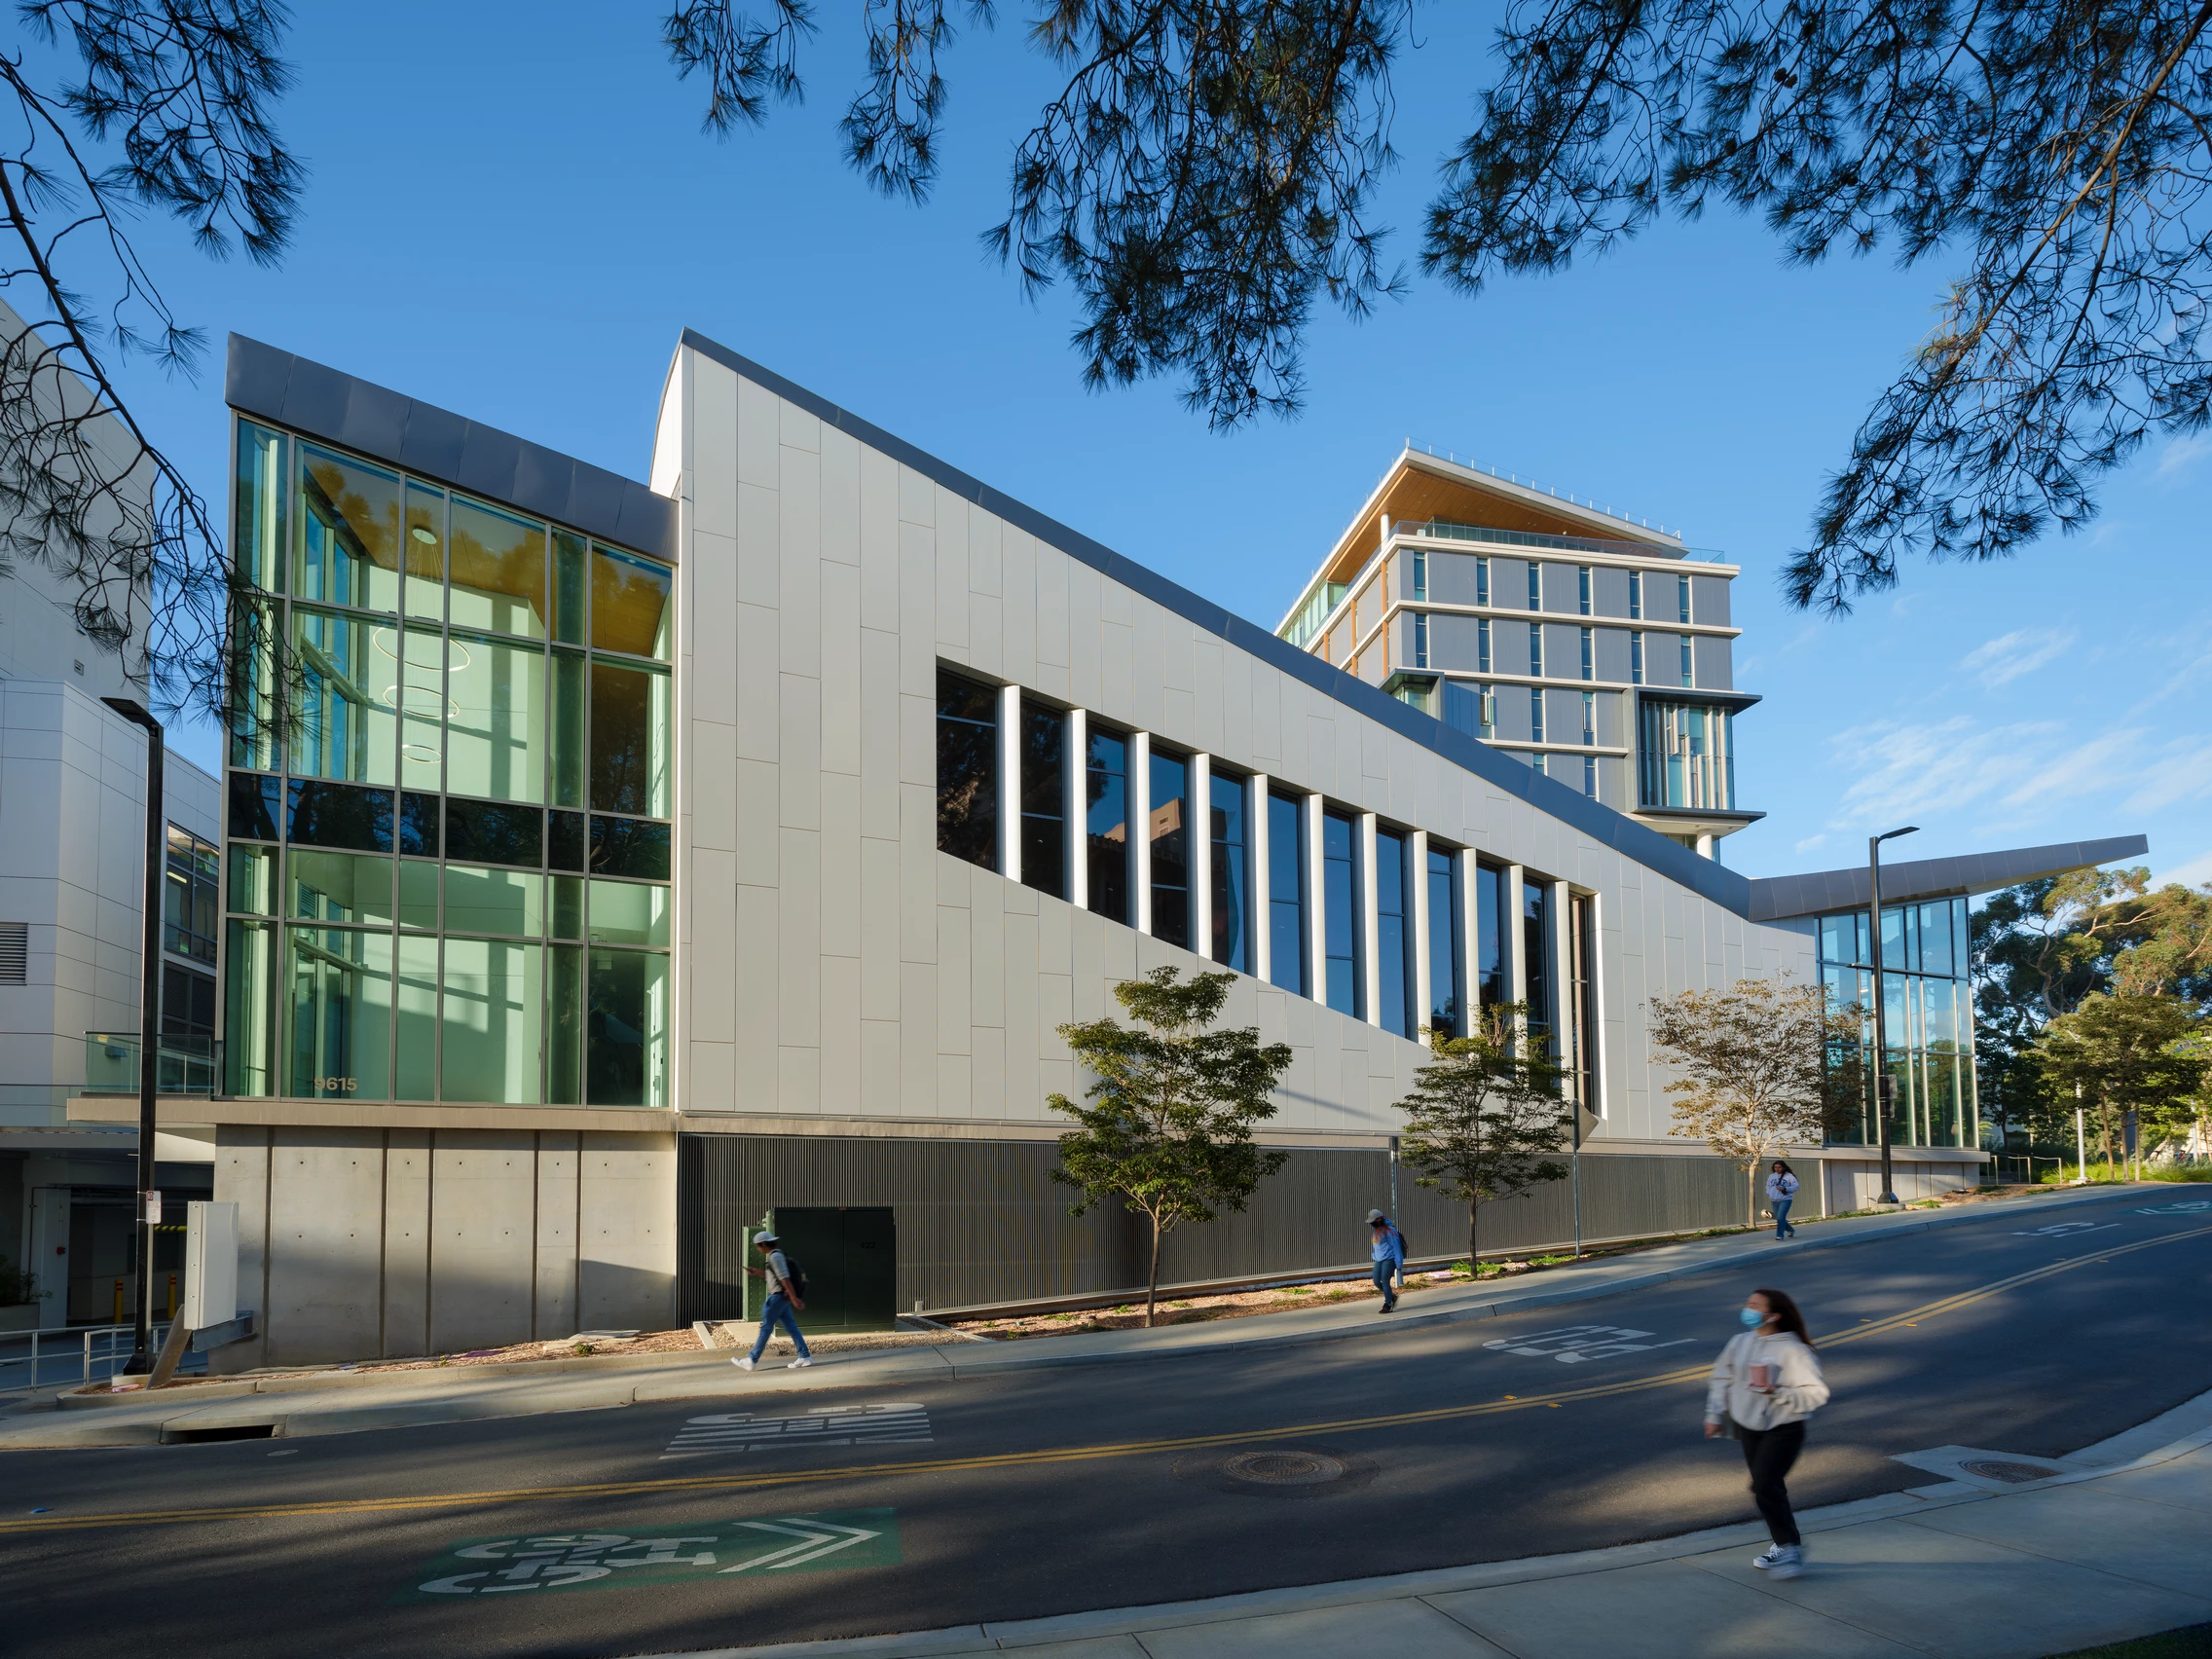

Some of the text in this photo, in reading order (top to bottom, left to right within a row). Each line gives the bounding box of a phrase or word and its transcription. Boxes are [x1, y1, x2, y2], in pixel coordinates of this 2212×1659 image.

[313, 1077, 358, 1091] 9615
[1482, 1325, 1698, 1364] PED
[658, 1402, 935, 1460] XING
